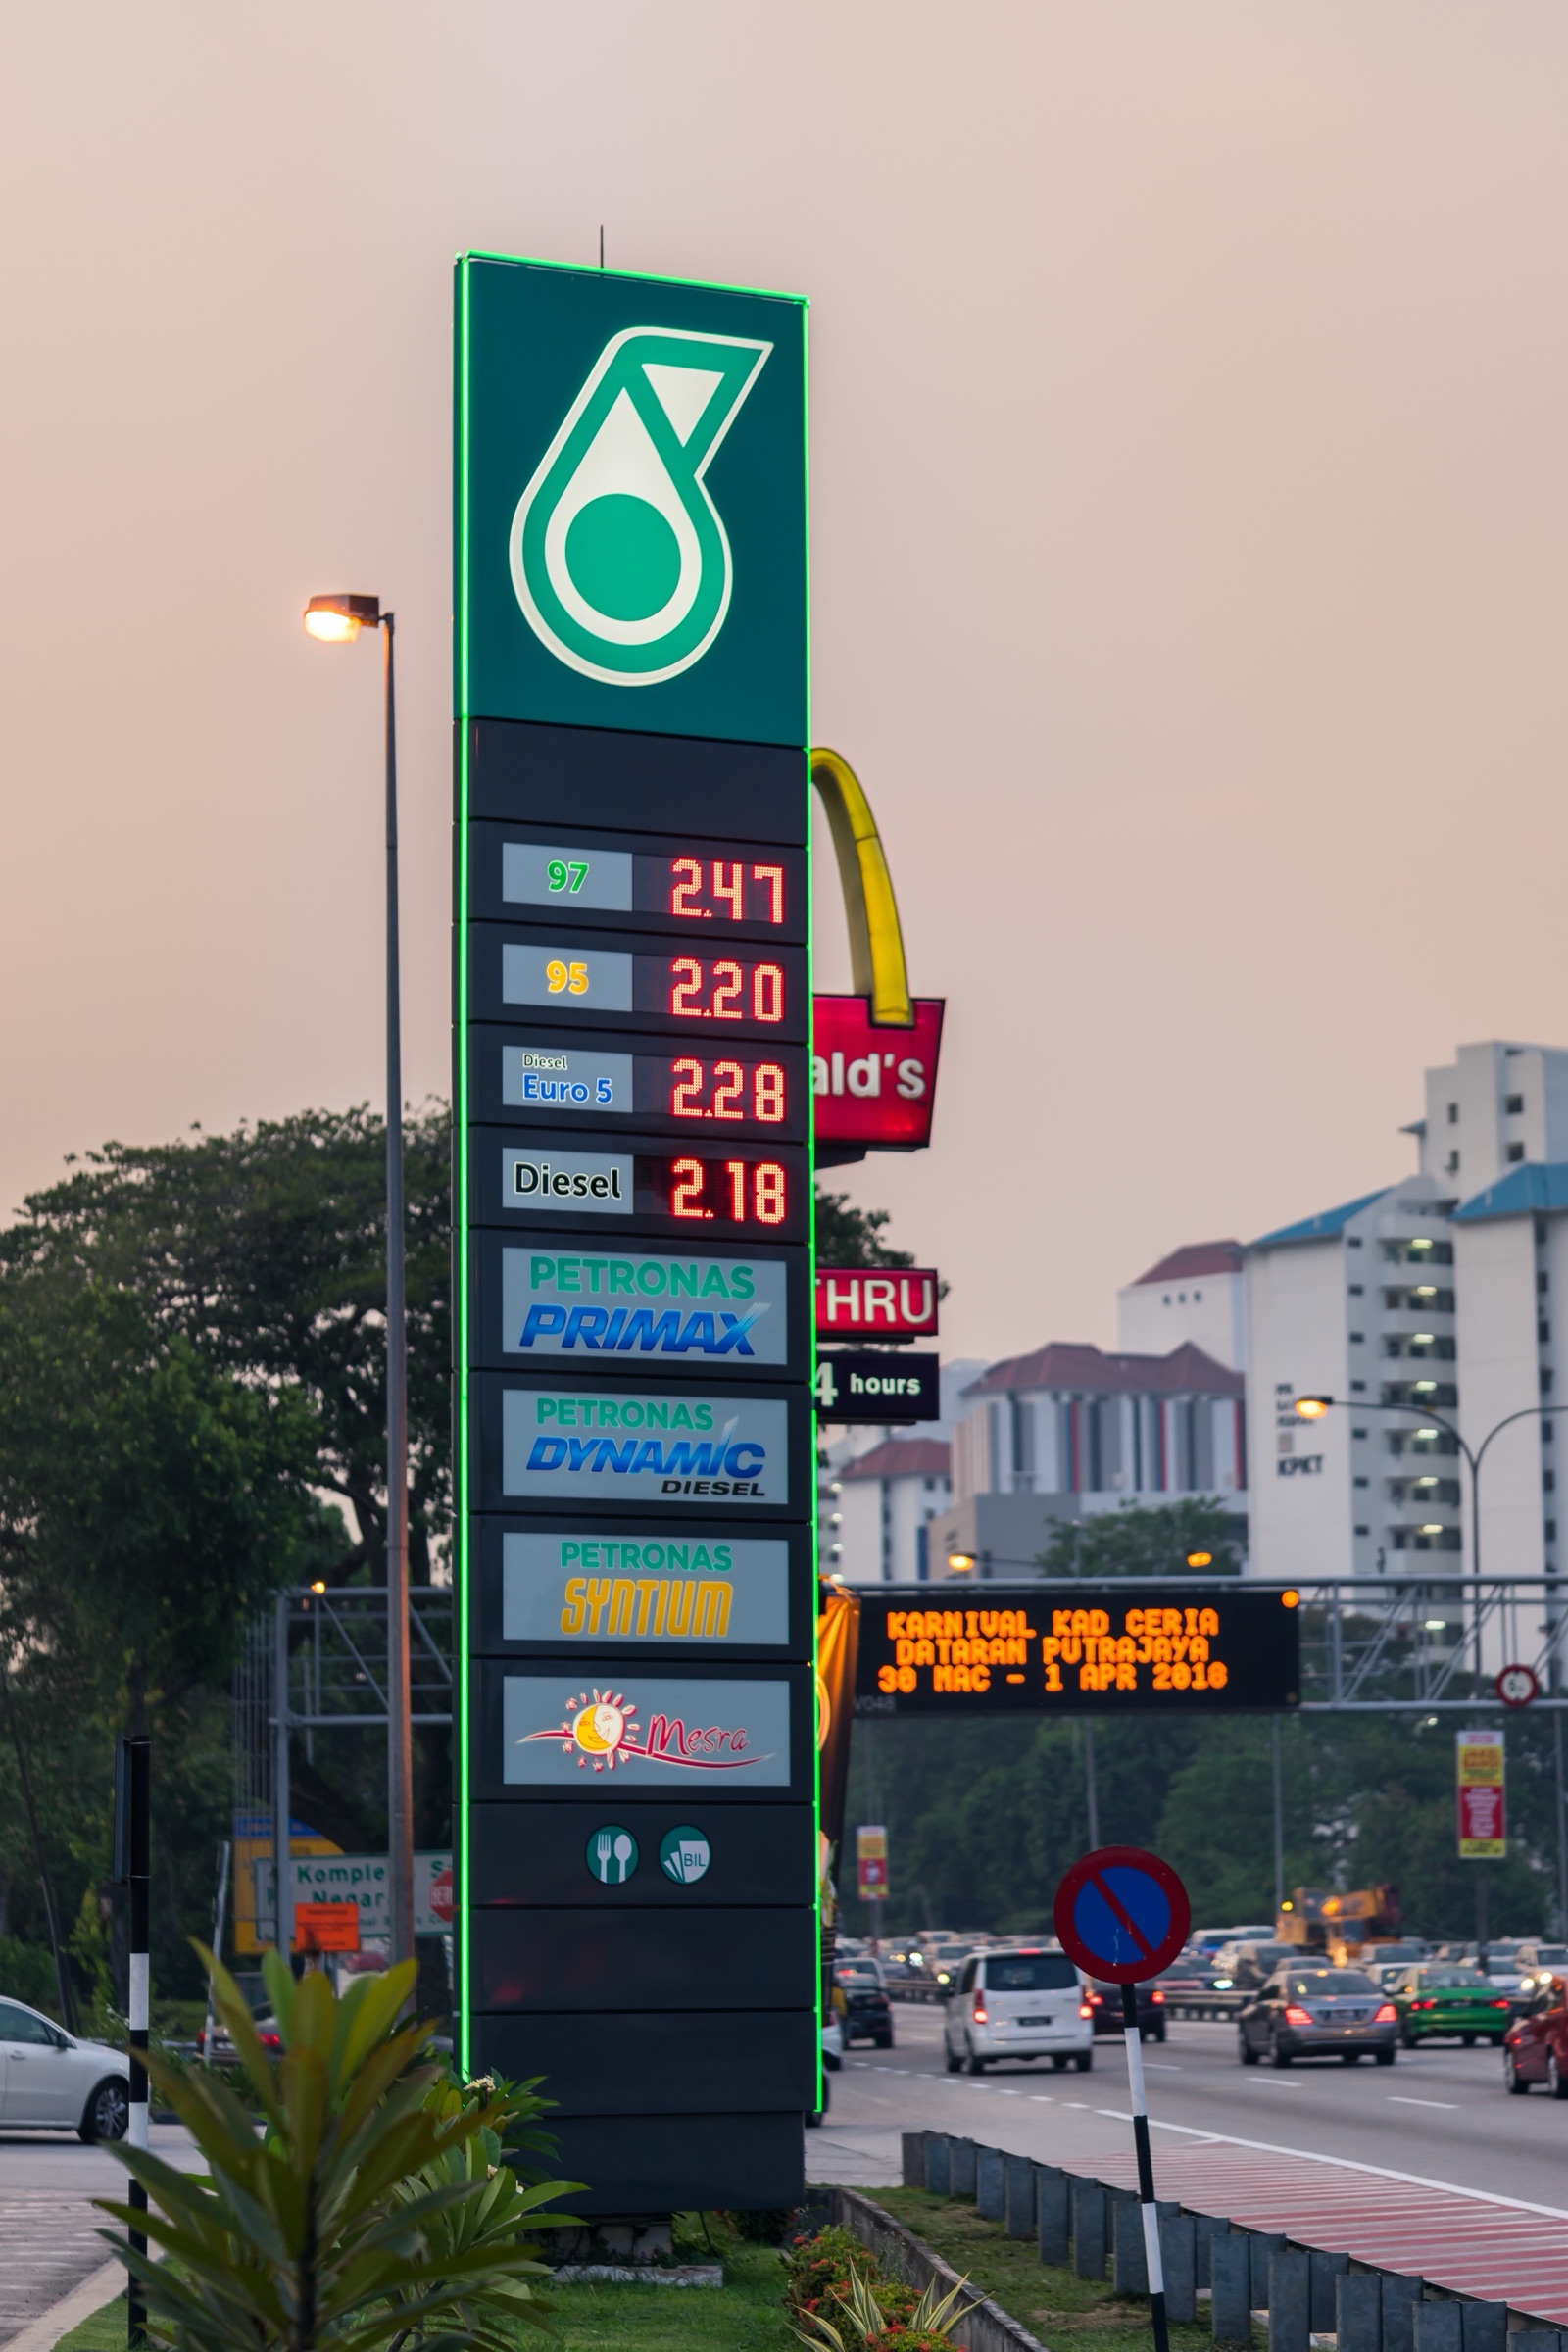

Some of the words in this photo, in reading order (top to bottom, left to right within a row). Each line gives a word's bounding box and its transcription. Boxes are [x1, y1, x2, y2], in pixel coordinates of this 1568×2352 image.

[547, 860, 589, 893] 97
[672, 858, 783, 923] 2.47
[546, 960, 589, 995] 95
[671, 958, 783, 1022] 2.20
[522, 1053, 567, 1070] Diesel
[522, 1074, 588, 1102] Euro
[596, 1078, 613, 1103] 5
[672, 1058, 784, 1122] 2.28
[514, 1162, 621, 1200] Diesel
[672, 1159, 785, 1224] 2.18
[529, 1256, 755, 1299] PETRONAS
[815, 1278, 932, 1324] HRU
[519, 1301, 771, 1355] PRIMAX
[850, 1373, 921, 1396] hours
[536, 1397, 713, 1430] PETRONAS
[526, 1416, 766, 1478] DYNAMIC
[661, 1480, 766, 1496] DIESEL
[560, 1542, 732, 1571] PETRONAS
[560, 1577, 733, 1637] SYNTIUM
[887, 1610, 1037, 1640] KARNIVAL
[1053, 1609, 1109, 1638] KAD
[1125, 1608, 1219, 1637] CERIA
[896, 1637, 1027, 1666] DATARAN
[1043, 1636, 1209, 1665] PUTRAJAYA
[877, 1665, 917, 1693] 30
[933, 1664, 991, 1692] MAC
[1006, 1673, 1025, 1684] -
[1045, 1664, 1064, 1691] 1
[1079, 1663, 1137, 1691] APR
[1152, 1661, 1228, 1690] 2018
[646, 1713, 750, 1756] Mesra
[297, 1864, 386, 1886] Komple
[684, 1853, 707, 1867] BIL
